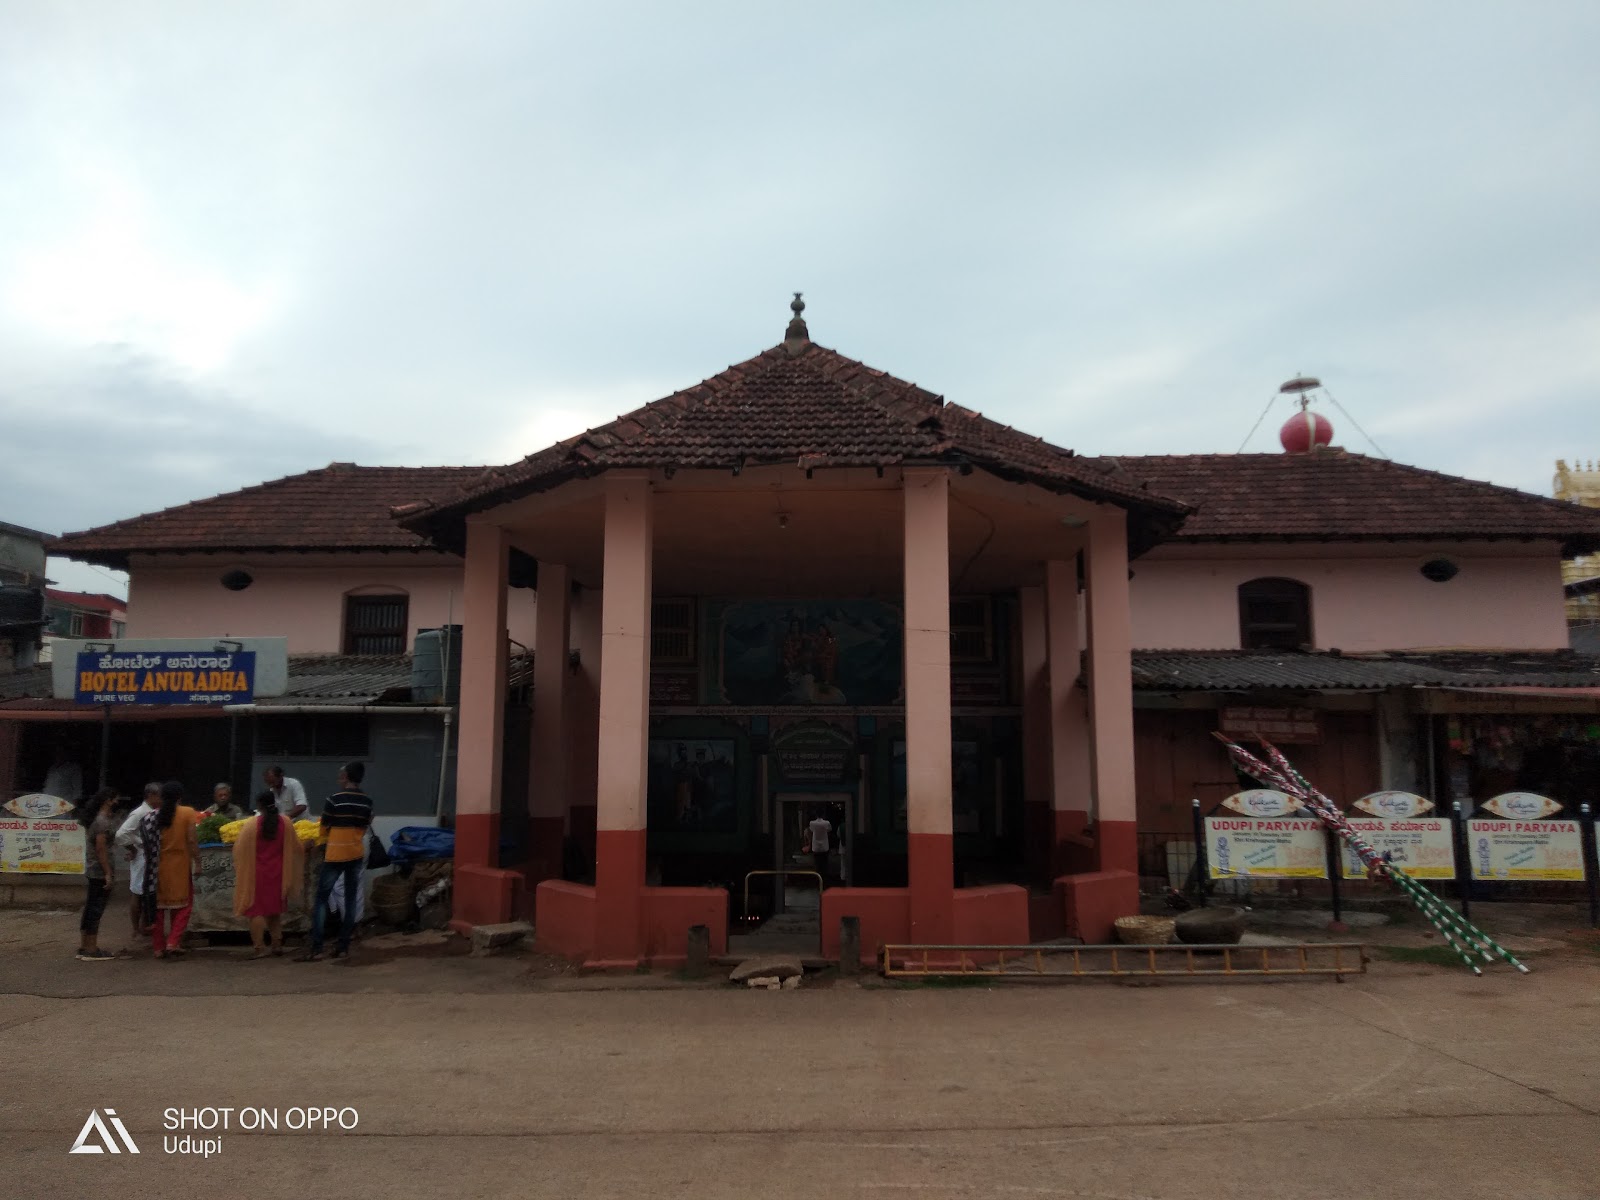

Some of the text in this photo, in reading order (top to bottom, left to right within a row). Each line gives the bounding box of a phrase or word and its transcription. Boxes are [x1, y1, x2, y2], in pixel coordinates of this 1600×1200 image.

[99, 654, 233, 671] ಹೋಟೆಲ್ ಅನುರಾಧ
[80, 671, 248, 692] HOTEL ANURADHA
[93, 694, 136, 702] PURE VEG
[1212, 821, 1319, 831] UDUPI PARYAYA
[1472, 822, 1576, 833] UDUPI PARYAYA
